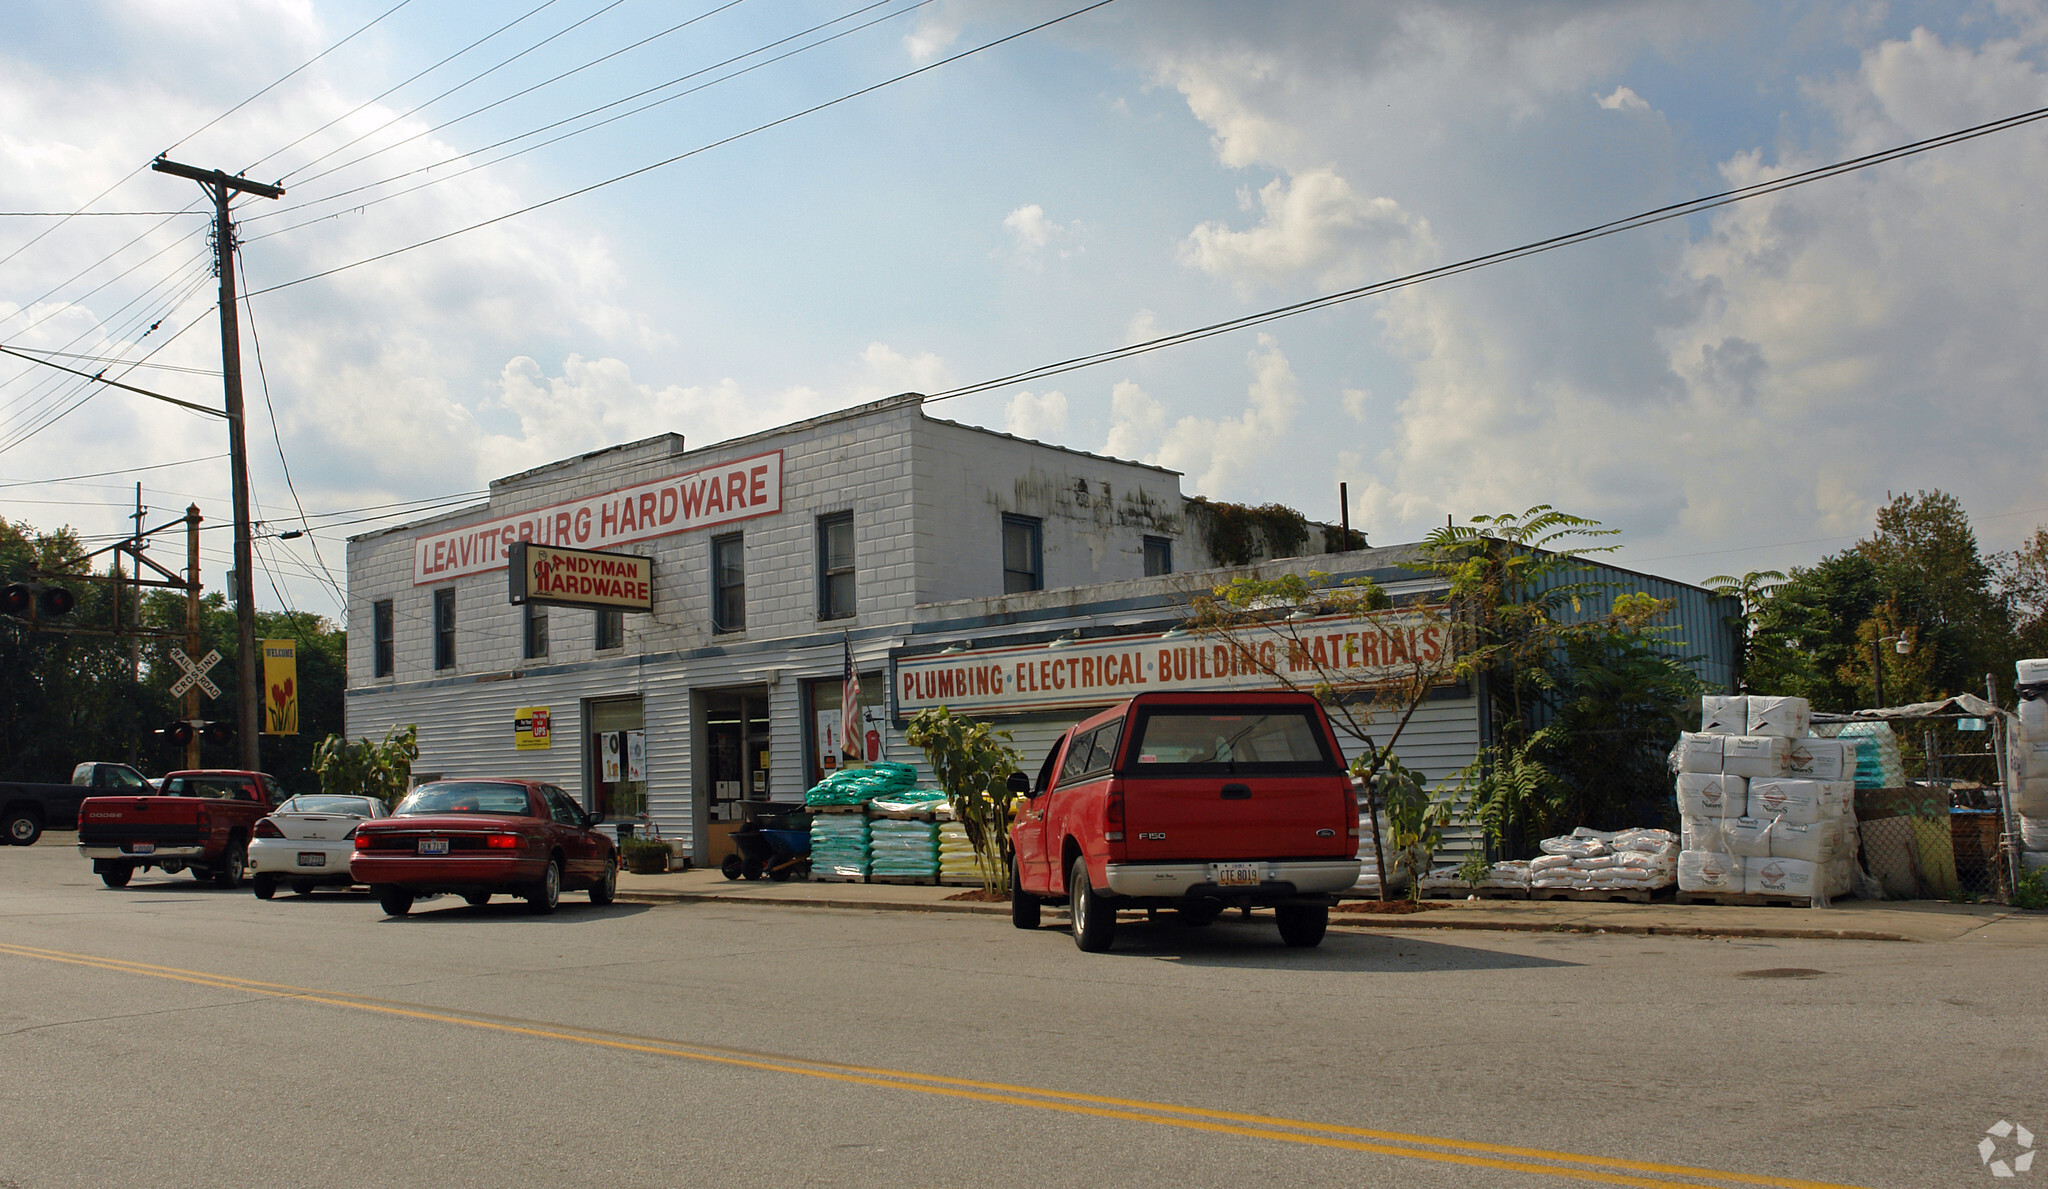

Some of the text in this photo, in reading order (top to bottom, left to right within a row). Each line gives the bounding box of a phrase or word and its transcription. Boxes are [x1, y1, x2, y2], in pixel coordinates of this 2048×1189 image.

[423, 464, 769, 575] LEAVITTSBURG HARDWARE
[172, 650, 191, 671] RAIL
[265, 648, 294, 658] WELCOME
[175, 654, 217, 694] CROSSING
[904, 627, 1442, 701] PLUMBING ELECTRICAL BUILDING MATERIALS
[198, 676, 219, 697] ROAD
[534, 726, 546, 736] UPS
[1220, 869, 1257, 882] CTE 8019
